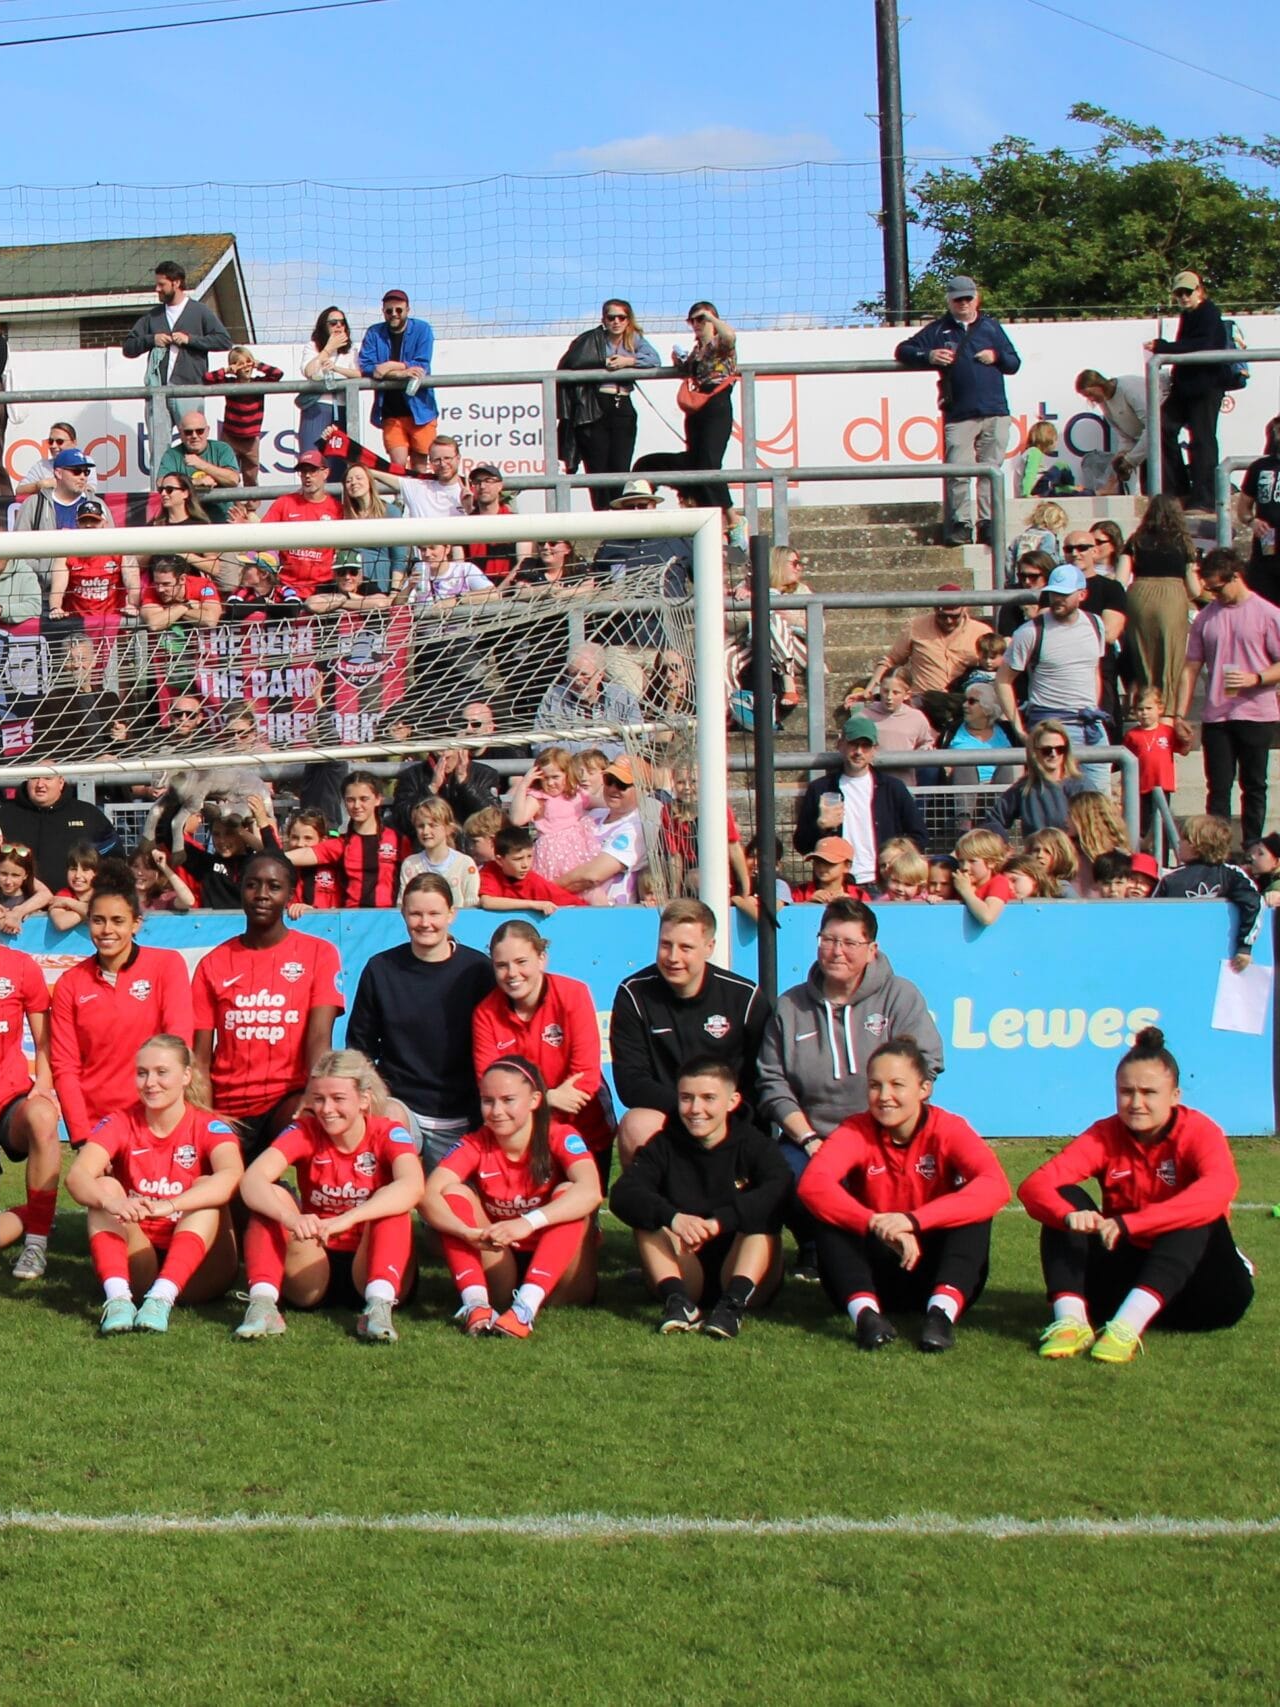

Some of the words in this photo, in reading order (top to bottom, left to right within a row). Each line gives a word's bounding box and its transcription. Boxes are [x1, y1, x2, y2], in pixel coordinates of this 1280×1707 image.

[441, 406, 463, 420] re
[468, 403, 540, 425] Suppo
[453, 430, 502, 448] erior
[509, 429, 543, 446] Sal
[199, 669, 244, 698] THE
[235, 989, 286, 1007] who
[225, 1010, 281, 1030] gives
[284, 1010, 300, 1023] a
[951, 997, 1160, 1049] Lewes
[235, 1026, 285, 1045] crap
[139, 1176, 184, 1196] who
[321, 1181, 370, 1199] who
